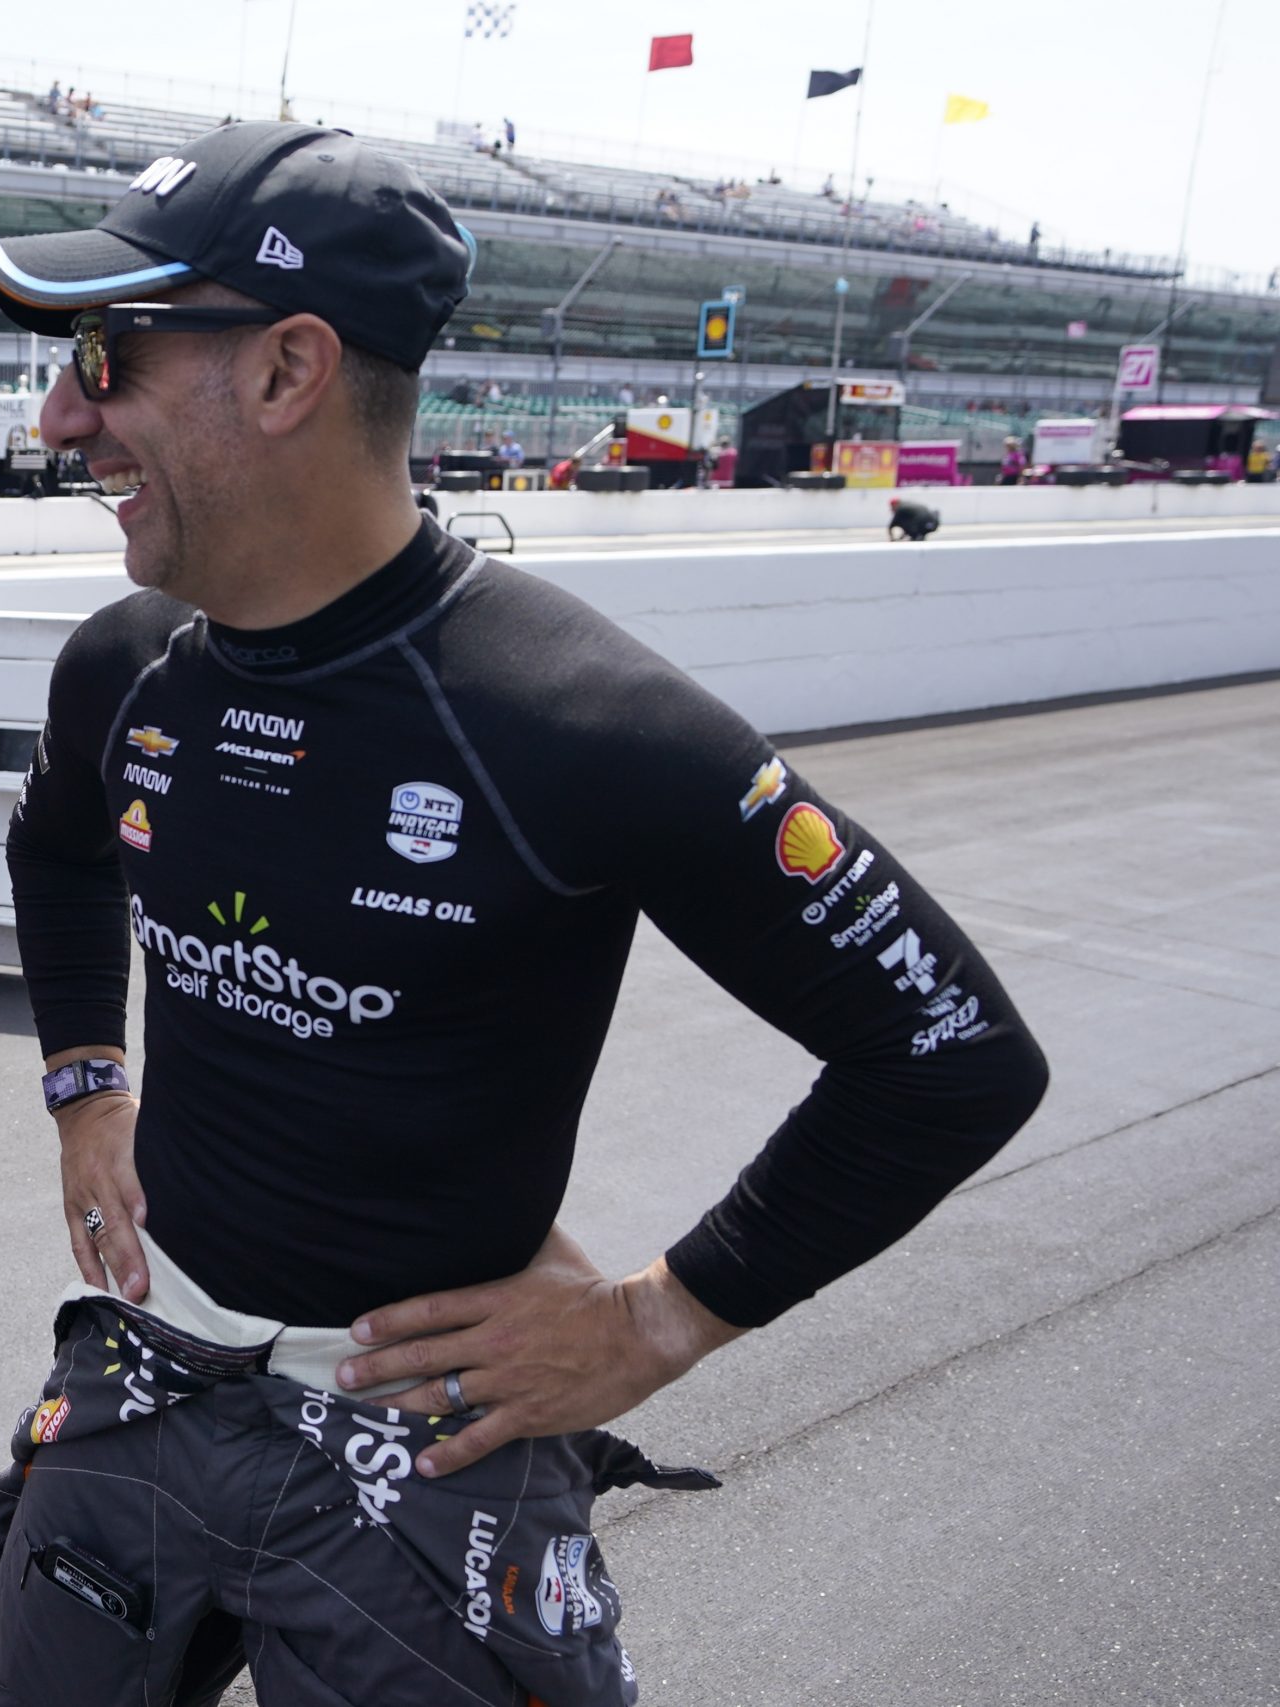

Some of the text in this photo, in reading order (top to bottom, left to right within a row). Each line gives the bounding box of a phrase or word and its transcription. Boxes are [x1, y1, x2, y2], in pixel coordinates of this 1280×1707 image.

[1122, 353, 1153, 385] 27
[215, 741, 296, 766] McLaren
[220, 773, 291, 796] INDYCAR TEAM
[424, 798, 456, 814] NTT
[387, 811, 460, 836] INDYCAR
[351, 887, 477, 924] LUCAS OIL
[131, 893, 395, 1025] SmartStop
[166, 962, 334, 1040] Self Storage
